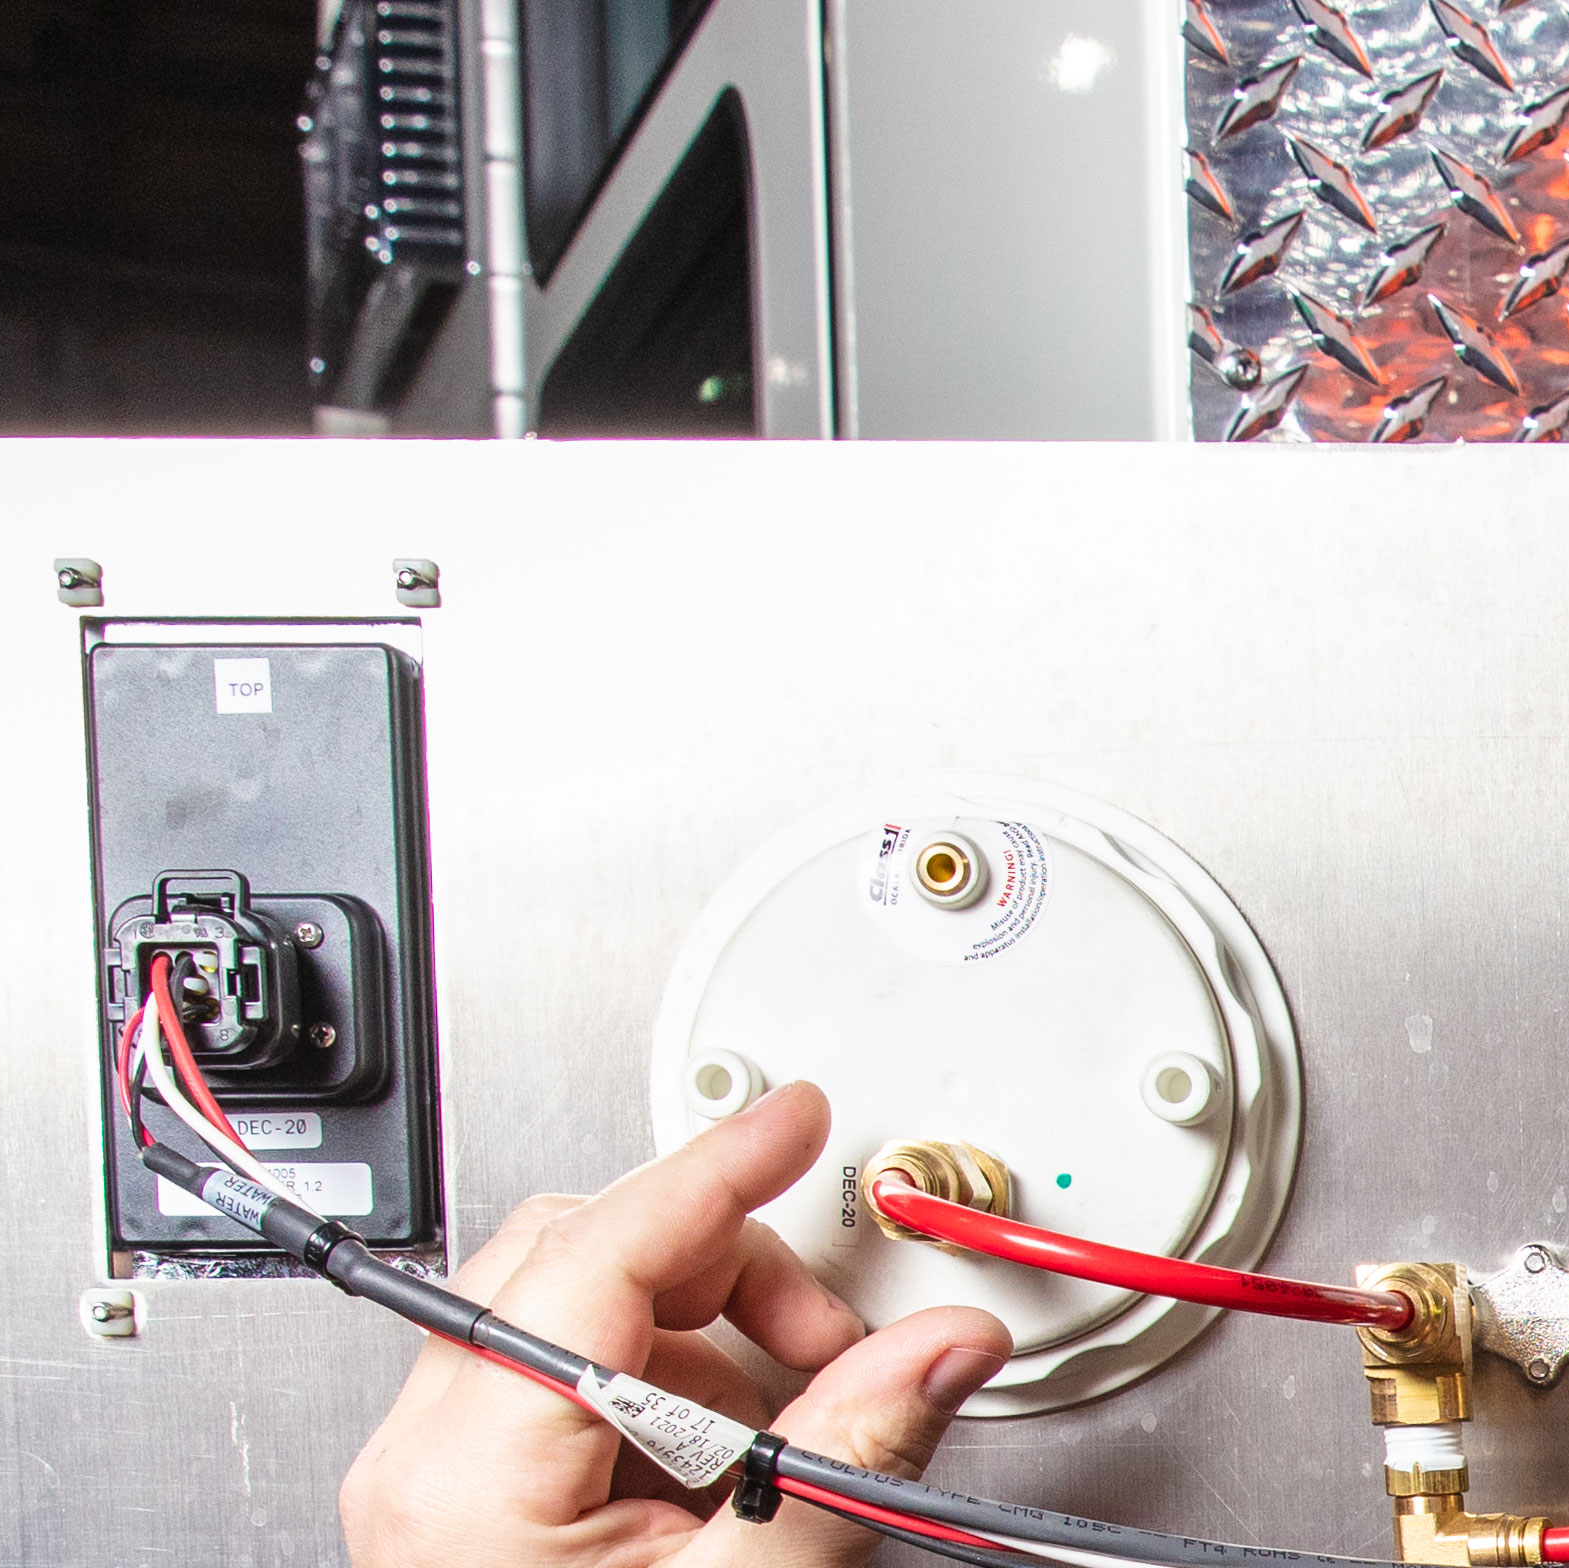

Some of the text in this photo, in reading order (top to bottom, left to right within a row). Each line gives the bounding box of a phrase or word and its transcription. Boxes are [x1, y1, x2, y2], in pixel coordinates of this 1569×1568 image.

[228, 682, 264, 697] TOP
[997, 849, 1016, 908] WARNING!
[990, 910, 1014, 931] Misuse
[1017, 868, 1027, 901] product
[972, 930, 1008, 950] explosion
[1018, 884, 1035, 919] personal
[964, 953, 979, 961] and
[981, 937, 1015, 959] apparatus
[237, 1119, 307, 1136] DEC-20
[224, 1176, 273, 1206] WATER
[304, 1181, 323, 1192] 1.2
[842, 1166, 857, 1228] DEC-20
[216, 1192, 260, 1226] WATER
[645, 1392, 716, 1434] 17 of 35
[650, 1415, 735, 1460] 02/18/2021
[676, 1441, 725, 1470] REV A
